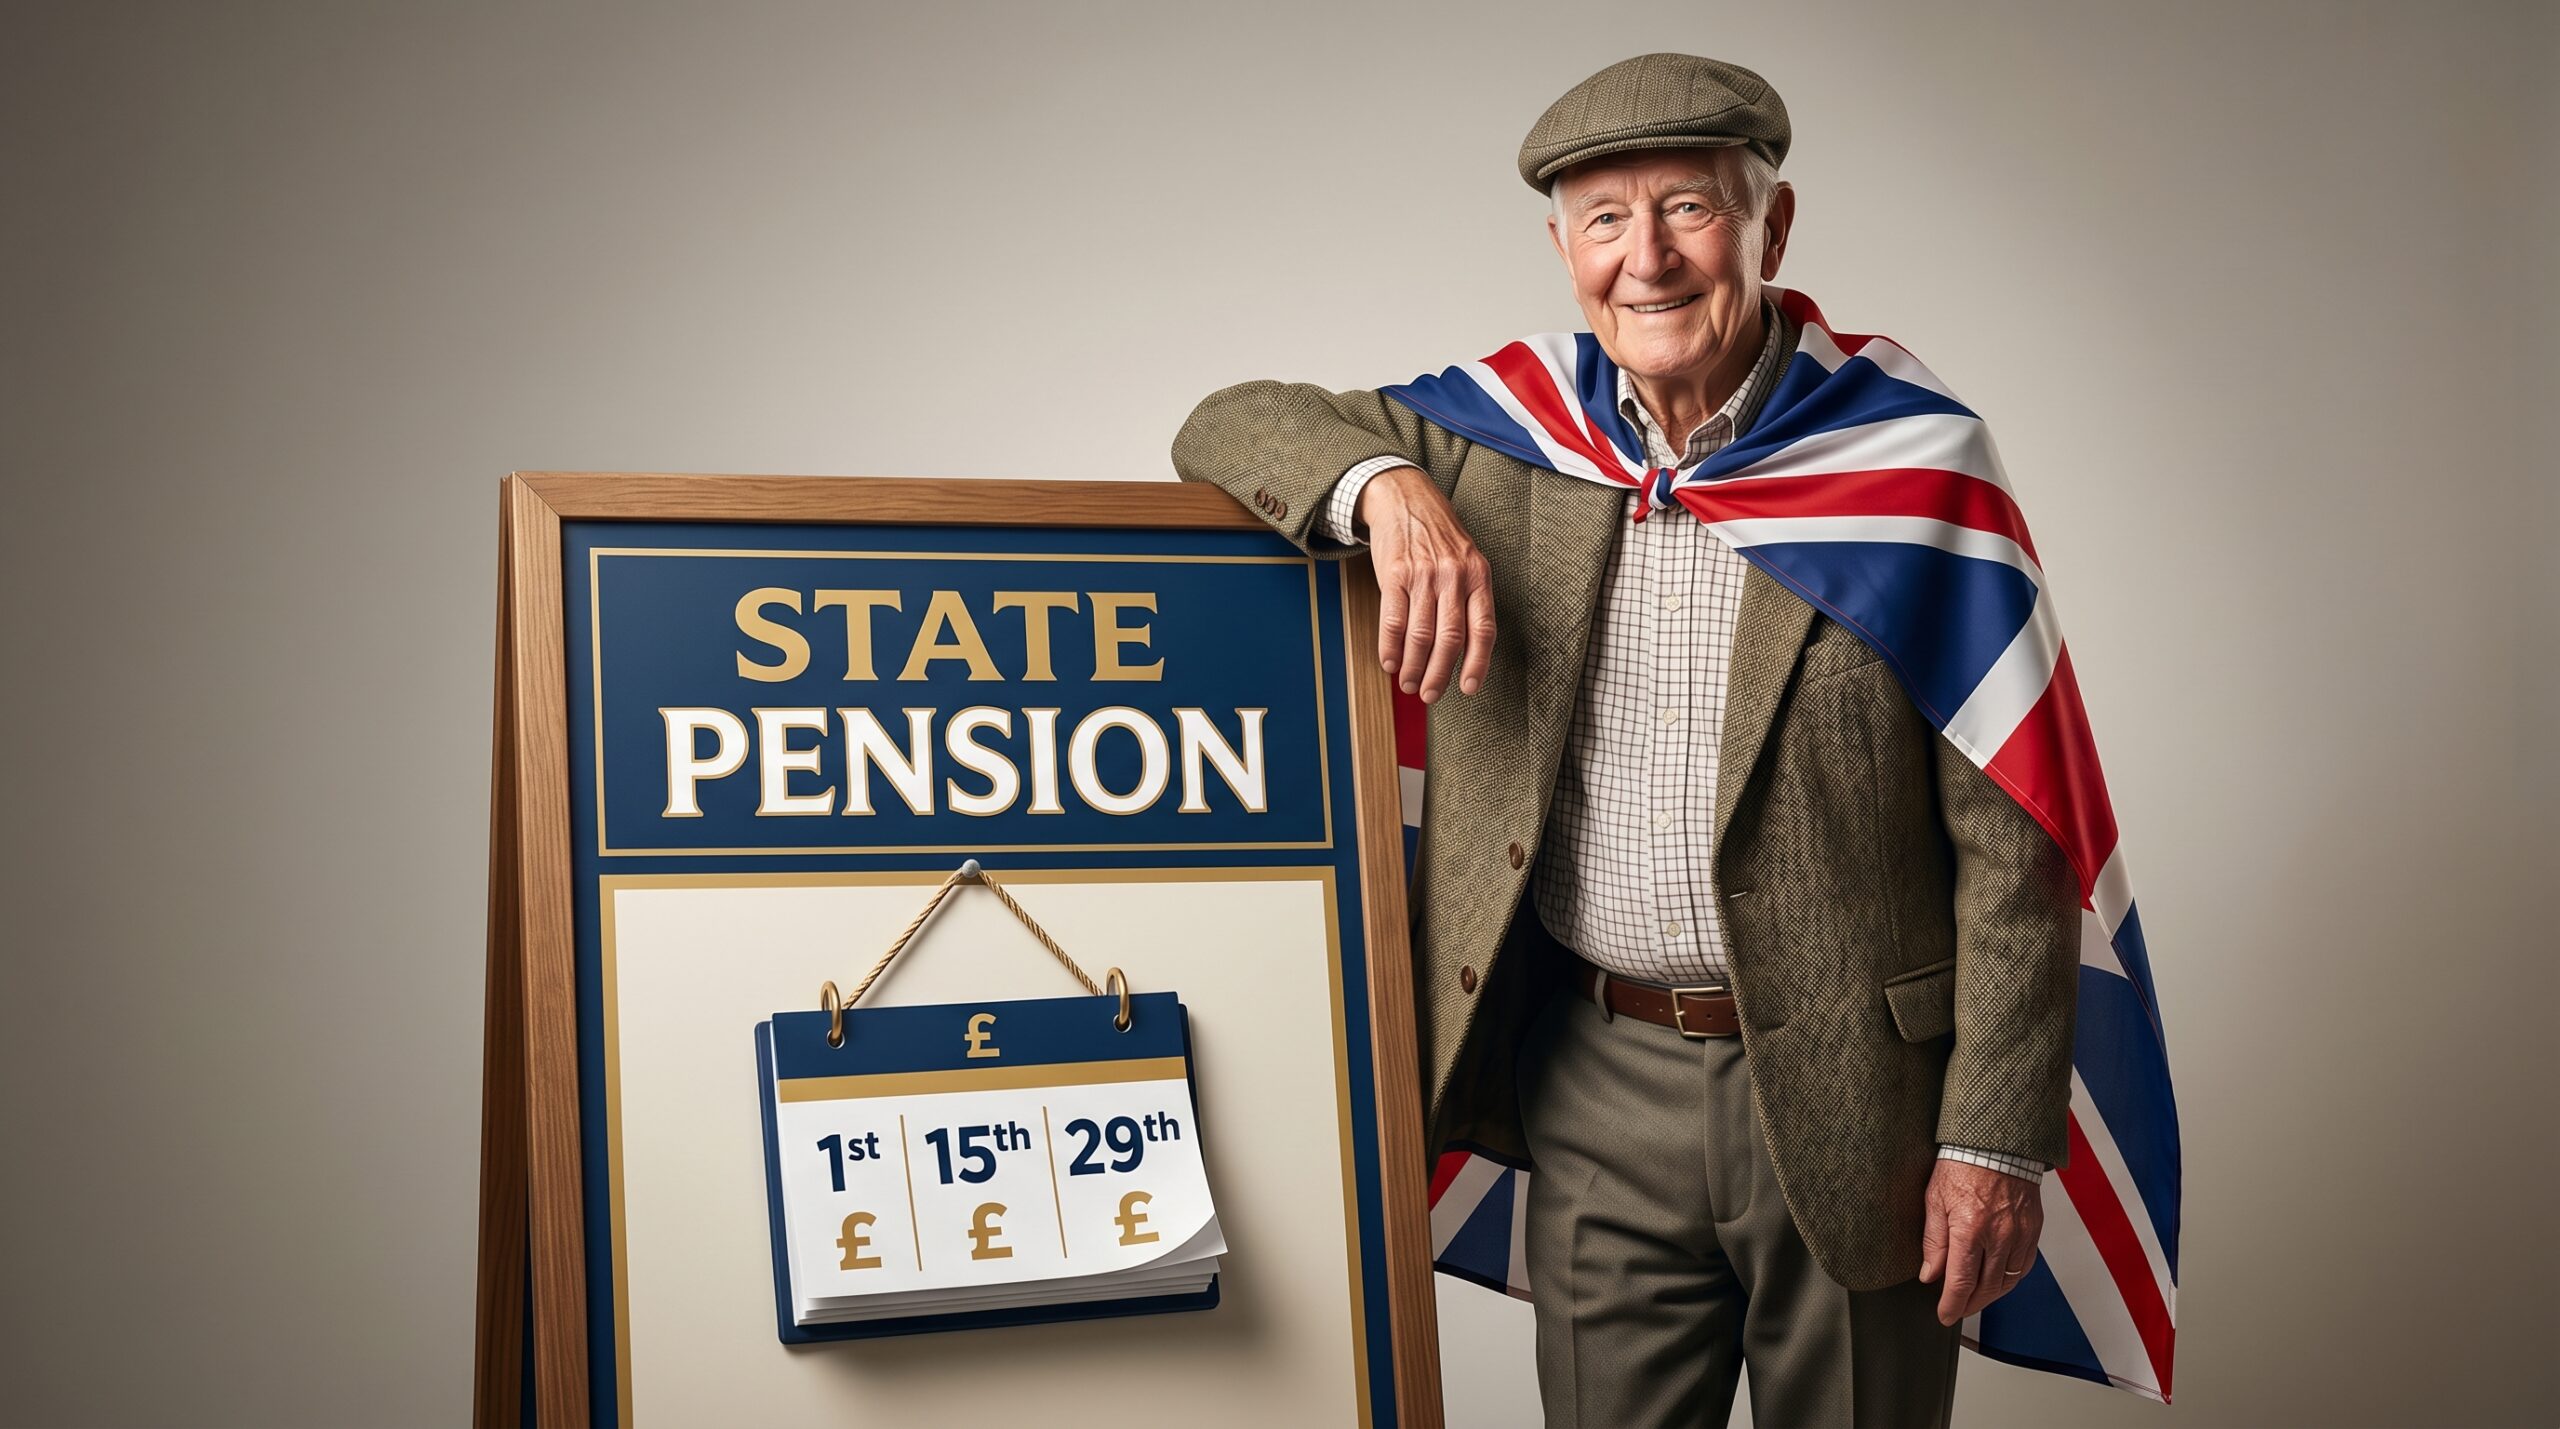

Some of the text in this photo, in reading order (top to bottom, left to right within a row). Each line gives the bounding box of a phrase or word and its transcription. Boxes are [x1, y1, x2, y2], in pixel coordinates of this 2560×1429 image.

[734, 587, 1165, 682] STATE
[659, 706, 1268, 818] PENSION
[964, 1013, 1000, 1059] £
[816, 1111, 1181, 1193] 1st 15th 29th
[836, 1190, 1160, 1271] £ £ £
